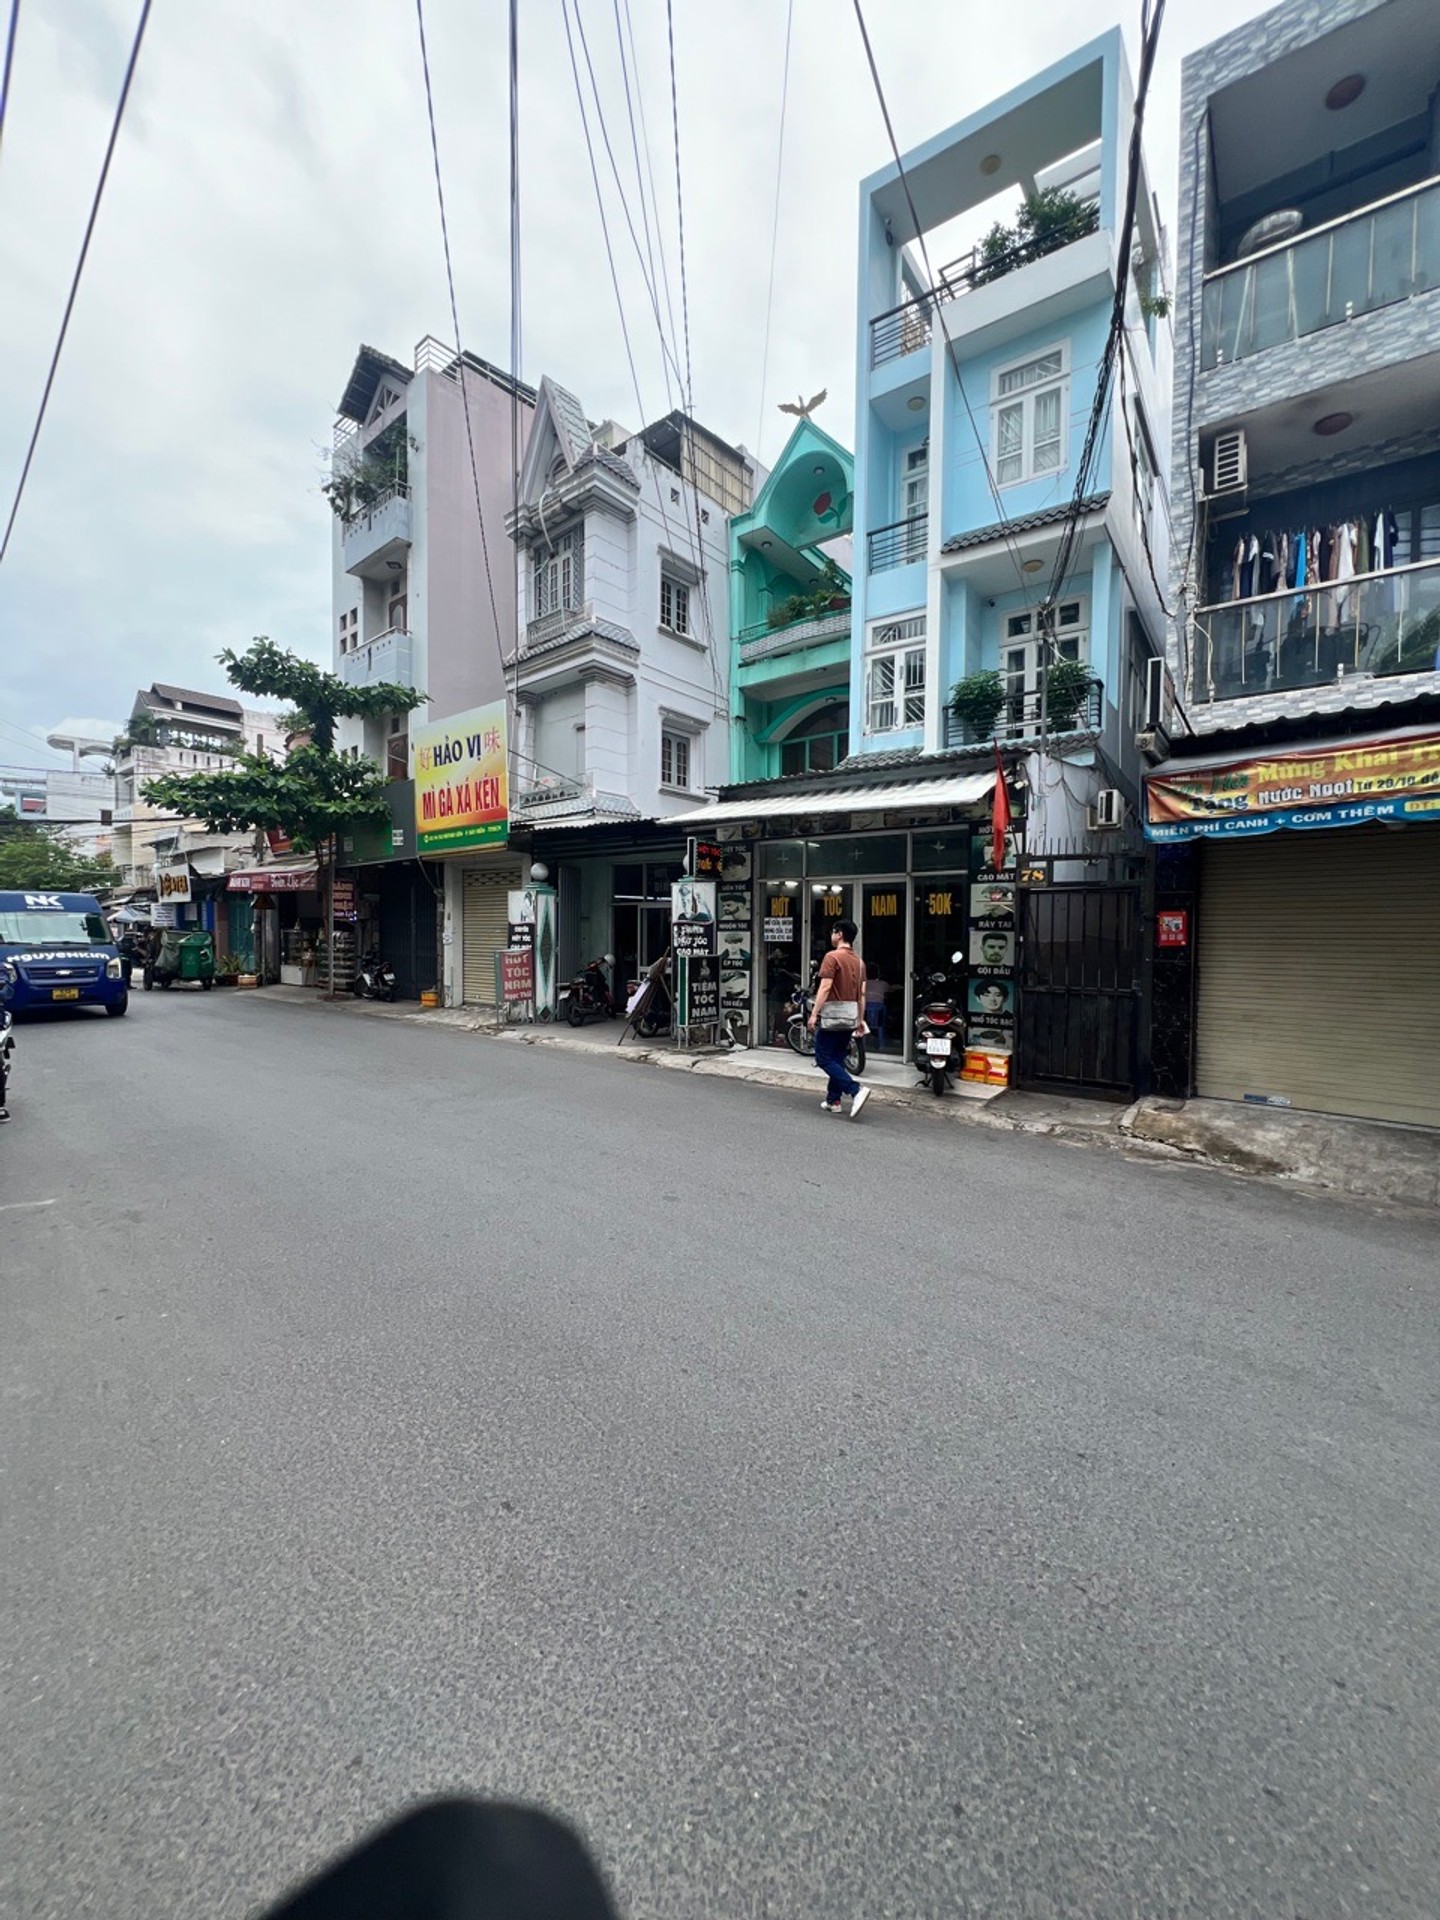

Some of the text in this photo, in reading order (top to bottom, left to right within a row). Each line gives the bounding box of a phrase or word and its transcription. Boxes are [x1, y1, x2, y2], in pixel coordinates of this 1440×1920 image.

[433, 732, 482, 768] HẢO VỊ
[1333, 745, 1398, 772] Khai
[422, 772, 500, 821] MÌ GÀ XÁ KÉN
[1257, 785, 1303, 806] Nước
[1193, 821, 1220, 834] PHÍ
[1224, 817, 1269, 831] CANH
[1291, 811, 1332, 824] CƠM
[1337, 804, 1395, 819] THÊM
[1021, 869, 1045, 882] 78
[24, 895, 63, 906] NK
[871, 894, 897, 917] NAM
[928, 892, 952, 915] 50K
[691, 1006, 717, 1018] NAM
